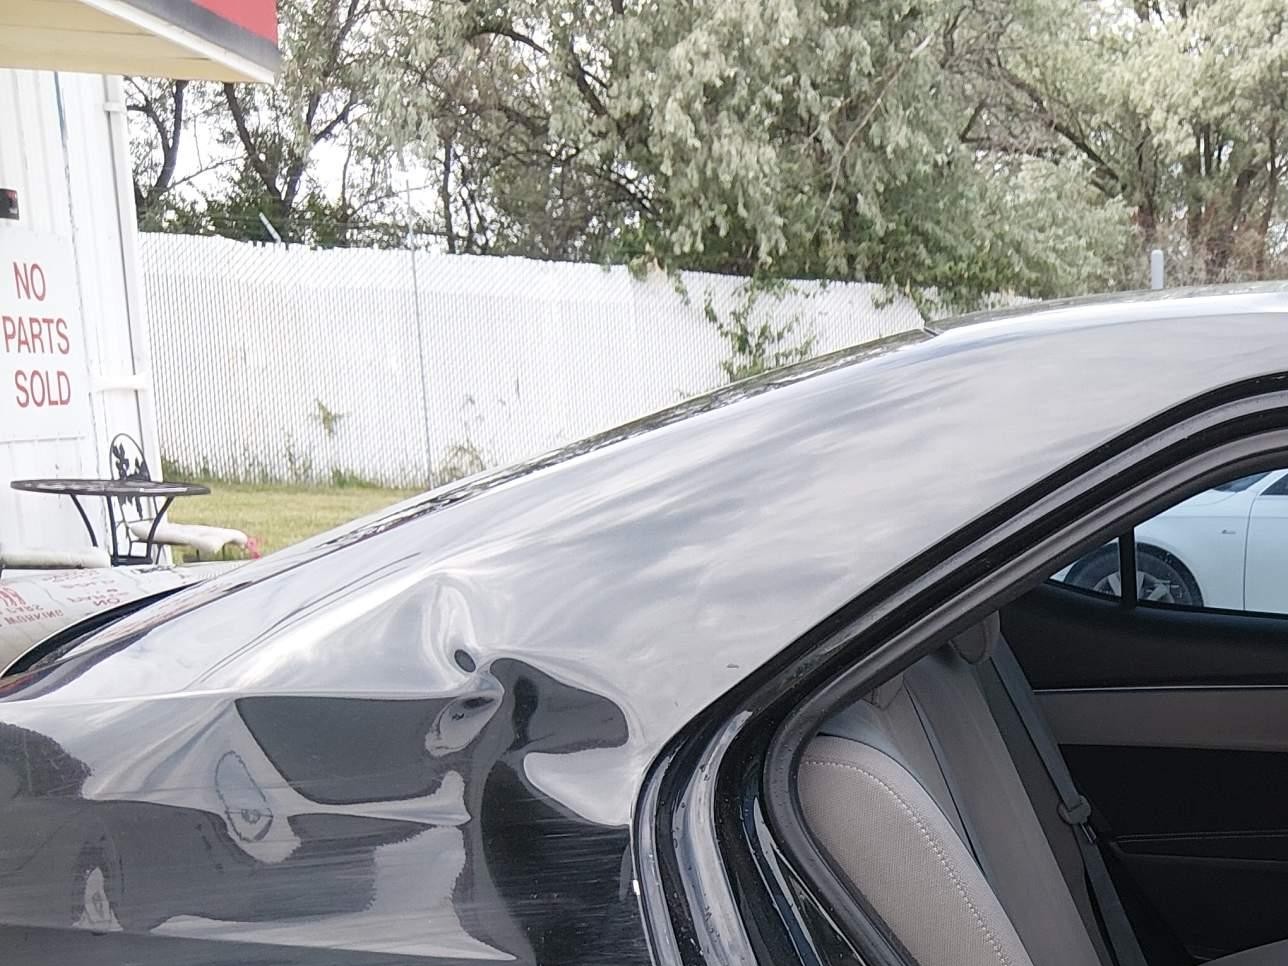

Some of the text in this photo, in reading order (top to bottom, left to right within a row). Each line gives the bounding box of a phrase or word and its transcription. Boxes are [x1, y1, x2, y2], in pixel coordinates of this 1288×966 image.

[13, 261, 46, 302] NO
[1, 315, 71, 355] PARTS
[14, 369, 72, 408] SOLD
